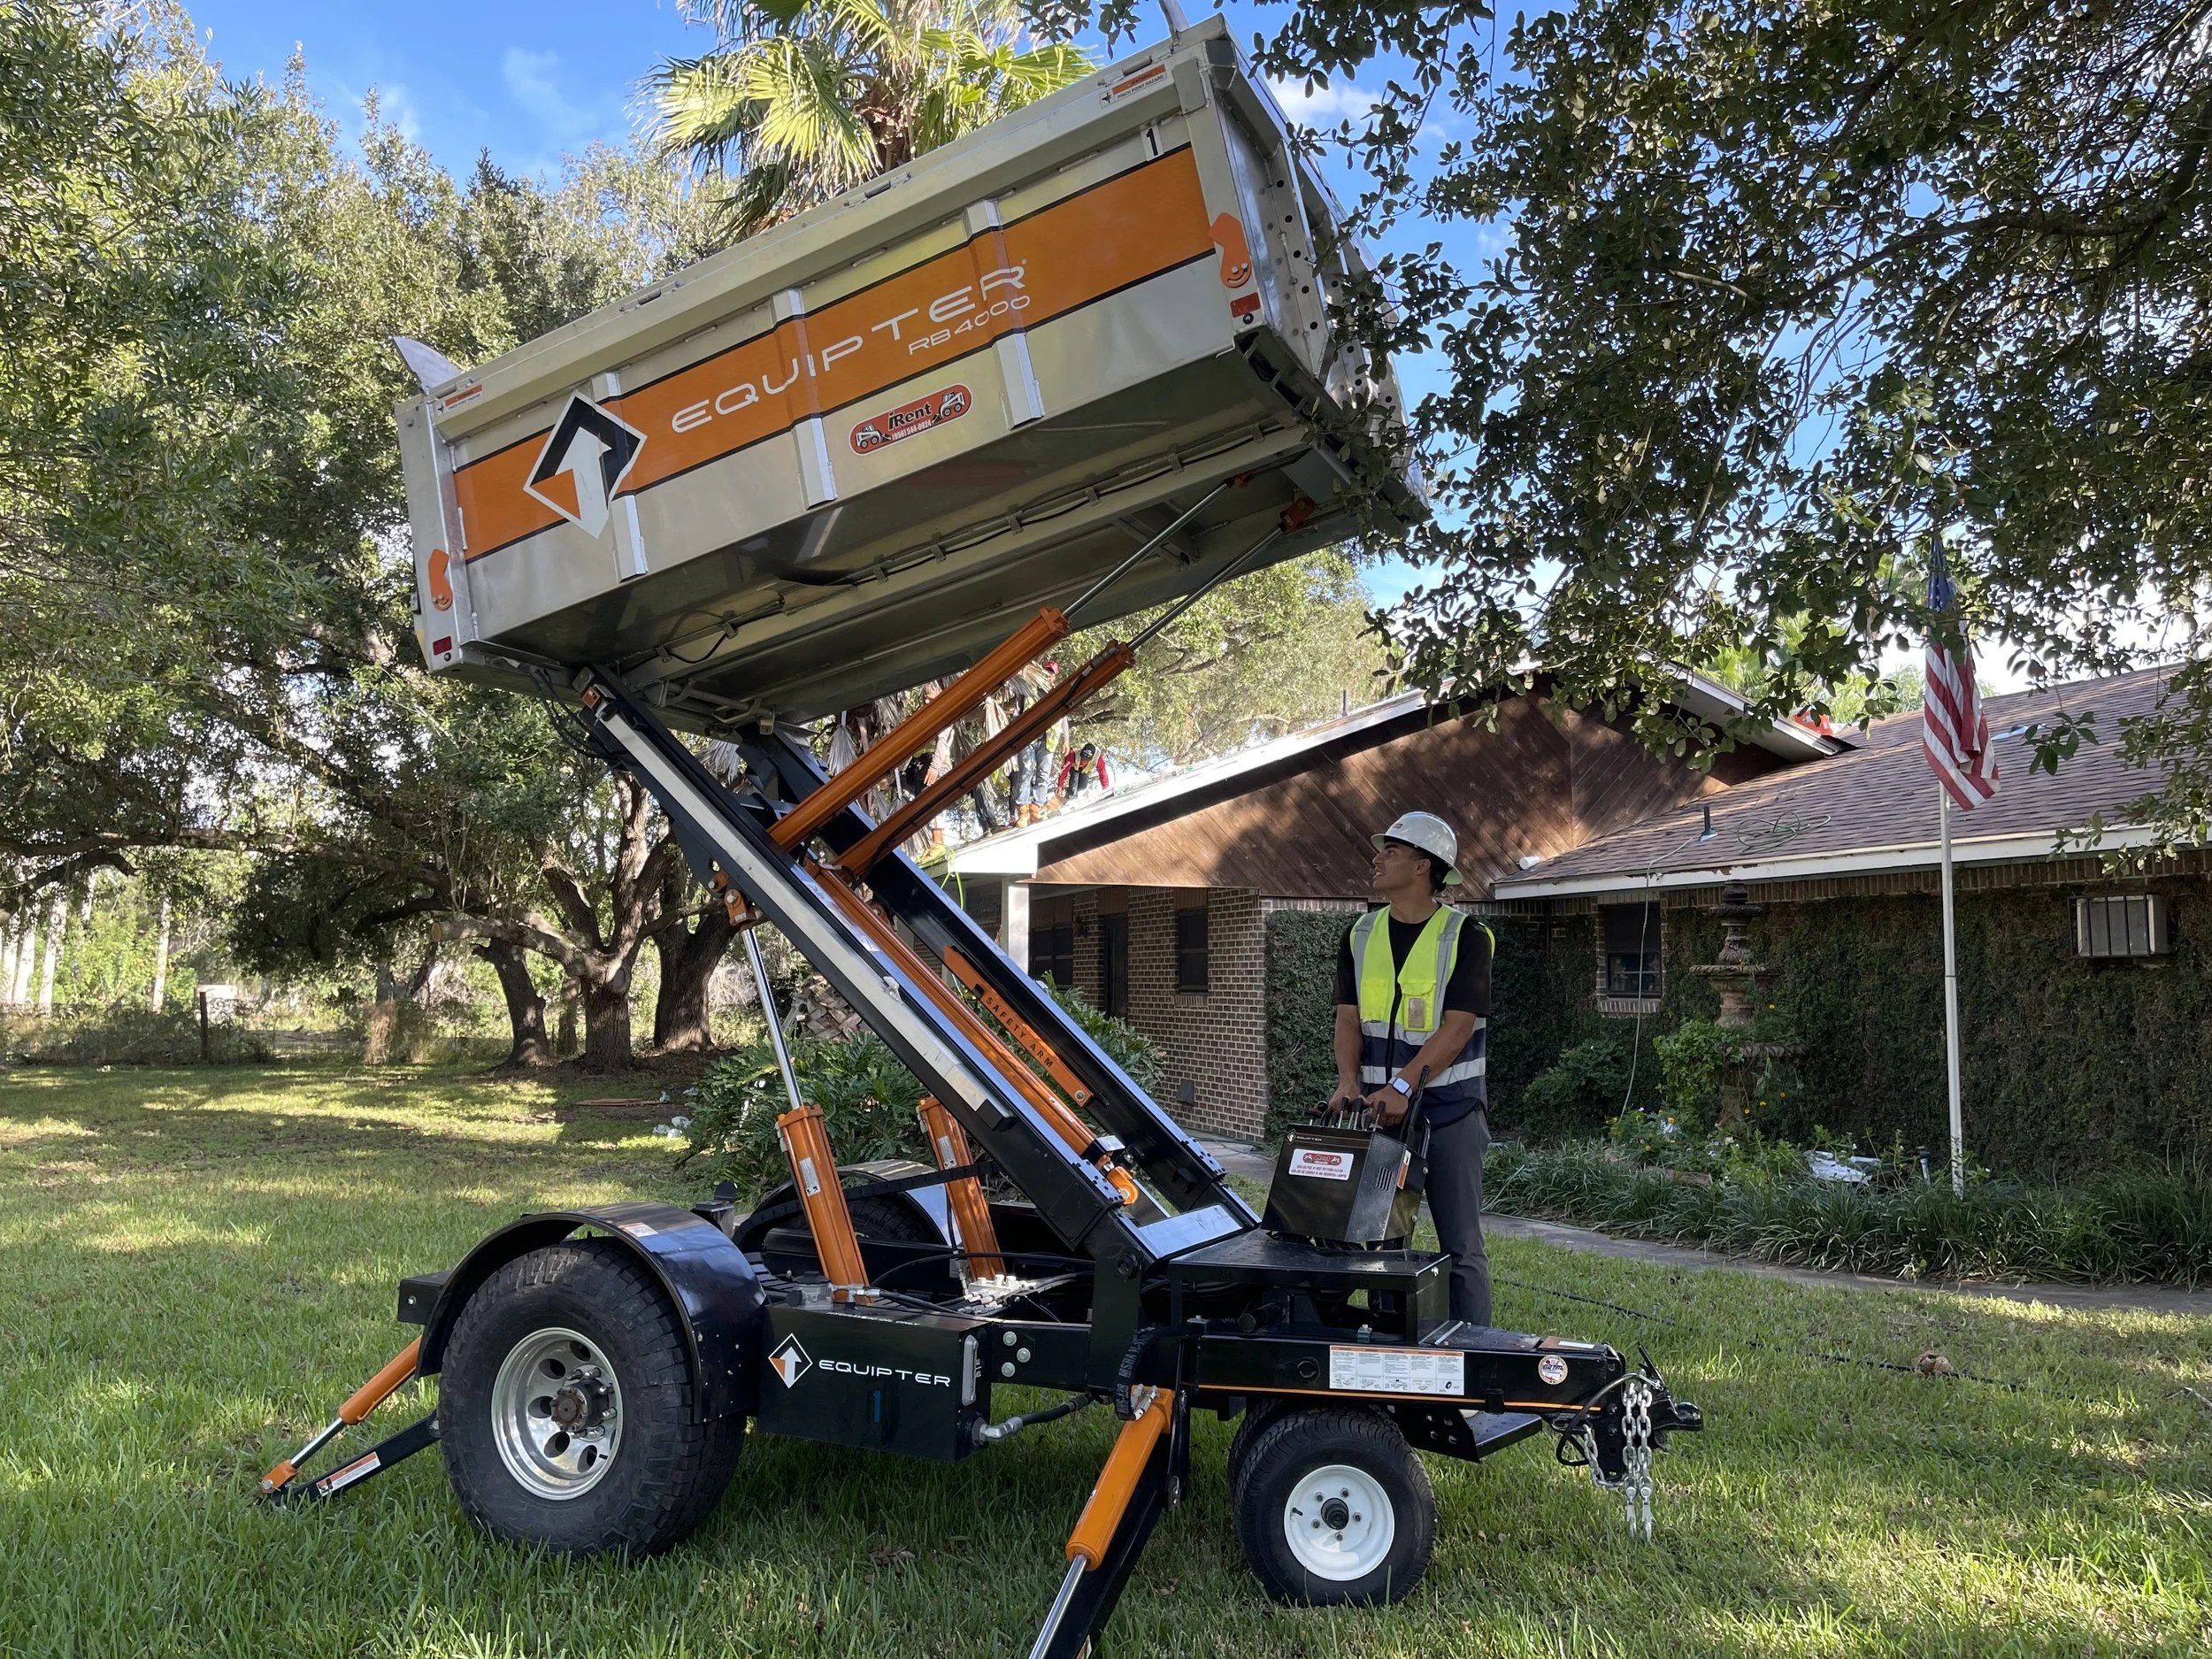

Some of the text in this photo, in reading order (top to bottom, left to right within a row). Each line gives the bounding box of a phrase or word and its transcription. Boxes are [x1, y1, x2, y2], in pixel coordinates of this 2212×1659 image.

[1132, 84, 1145, 93] POINT
[1146, 74, 1164, 86] HAZARD
[1146, 127, 1158, 157] 1
[908, 295, 1030, 355] RB4000
[672, 265, 1025, 434] EQUIPTER
[888, 402, 932, 430] iRent
[987, 997, 1054, 1067] SAFETY ARM
[818, 1359, 951, 1387] EQUIPTER
[1118, 1354, 1137, 1378] MSHA
